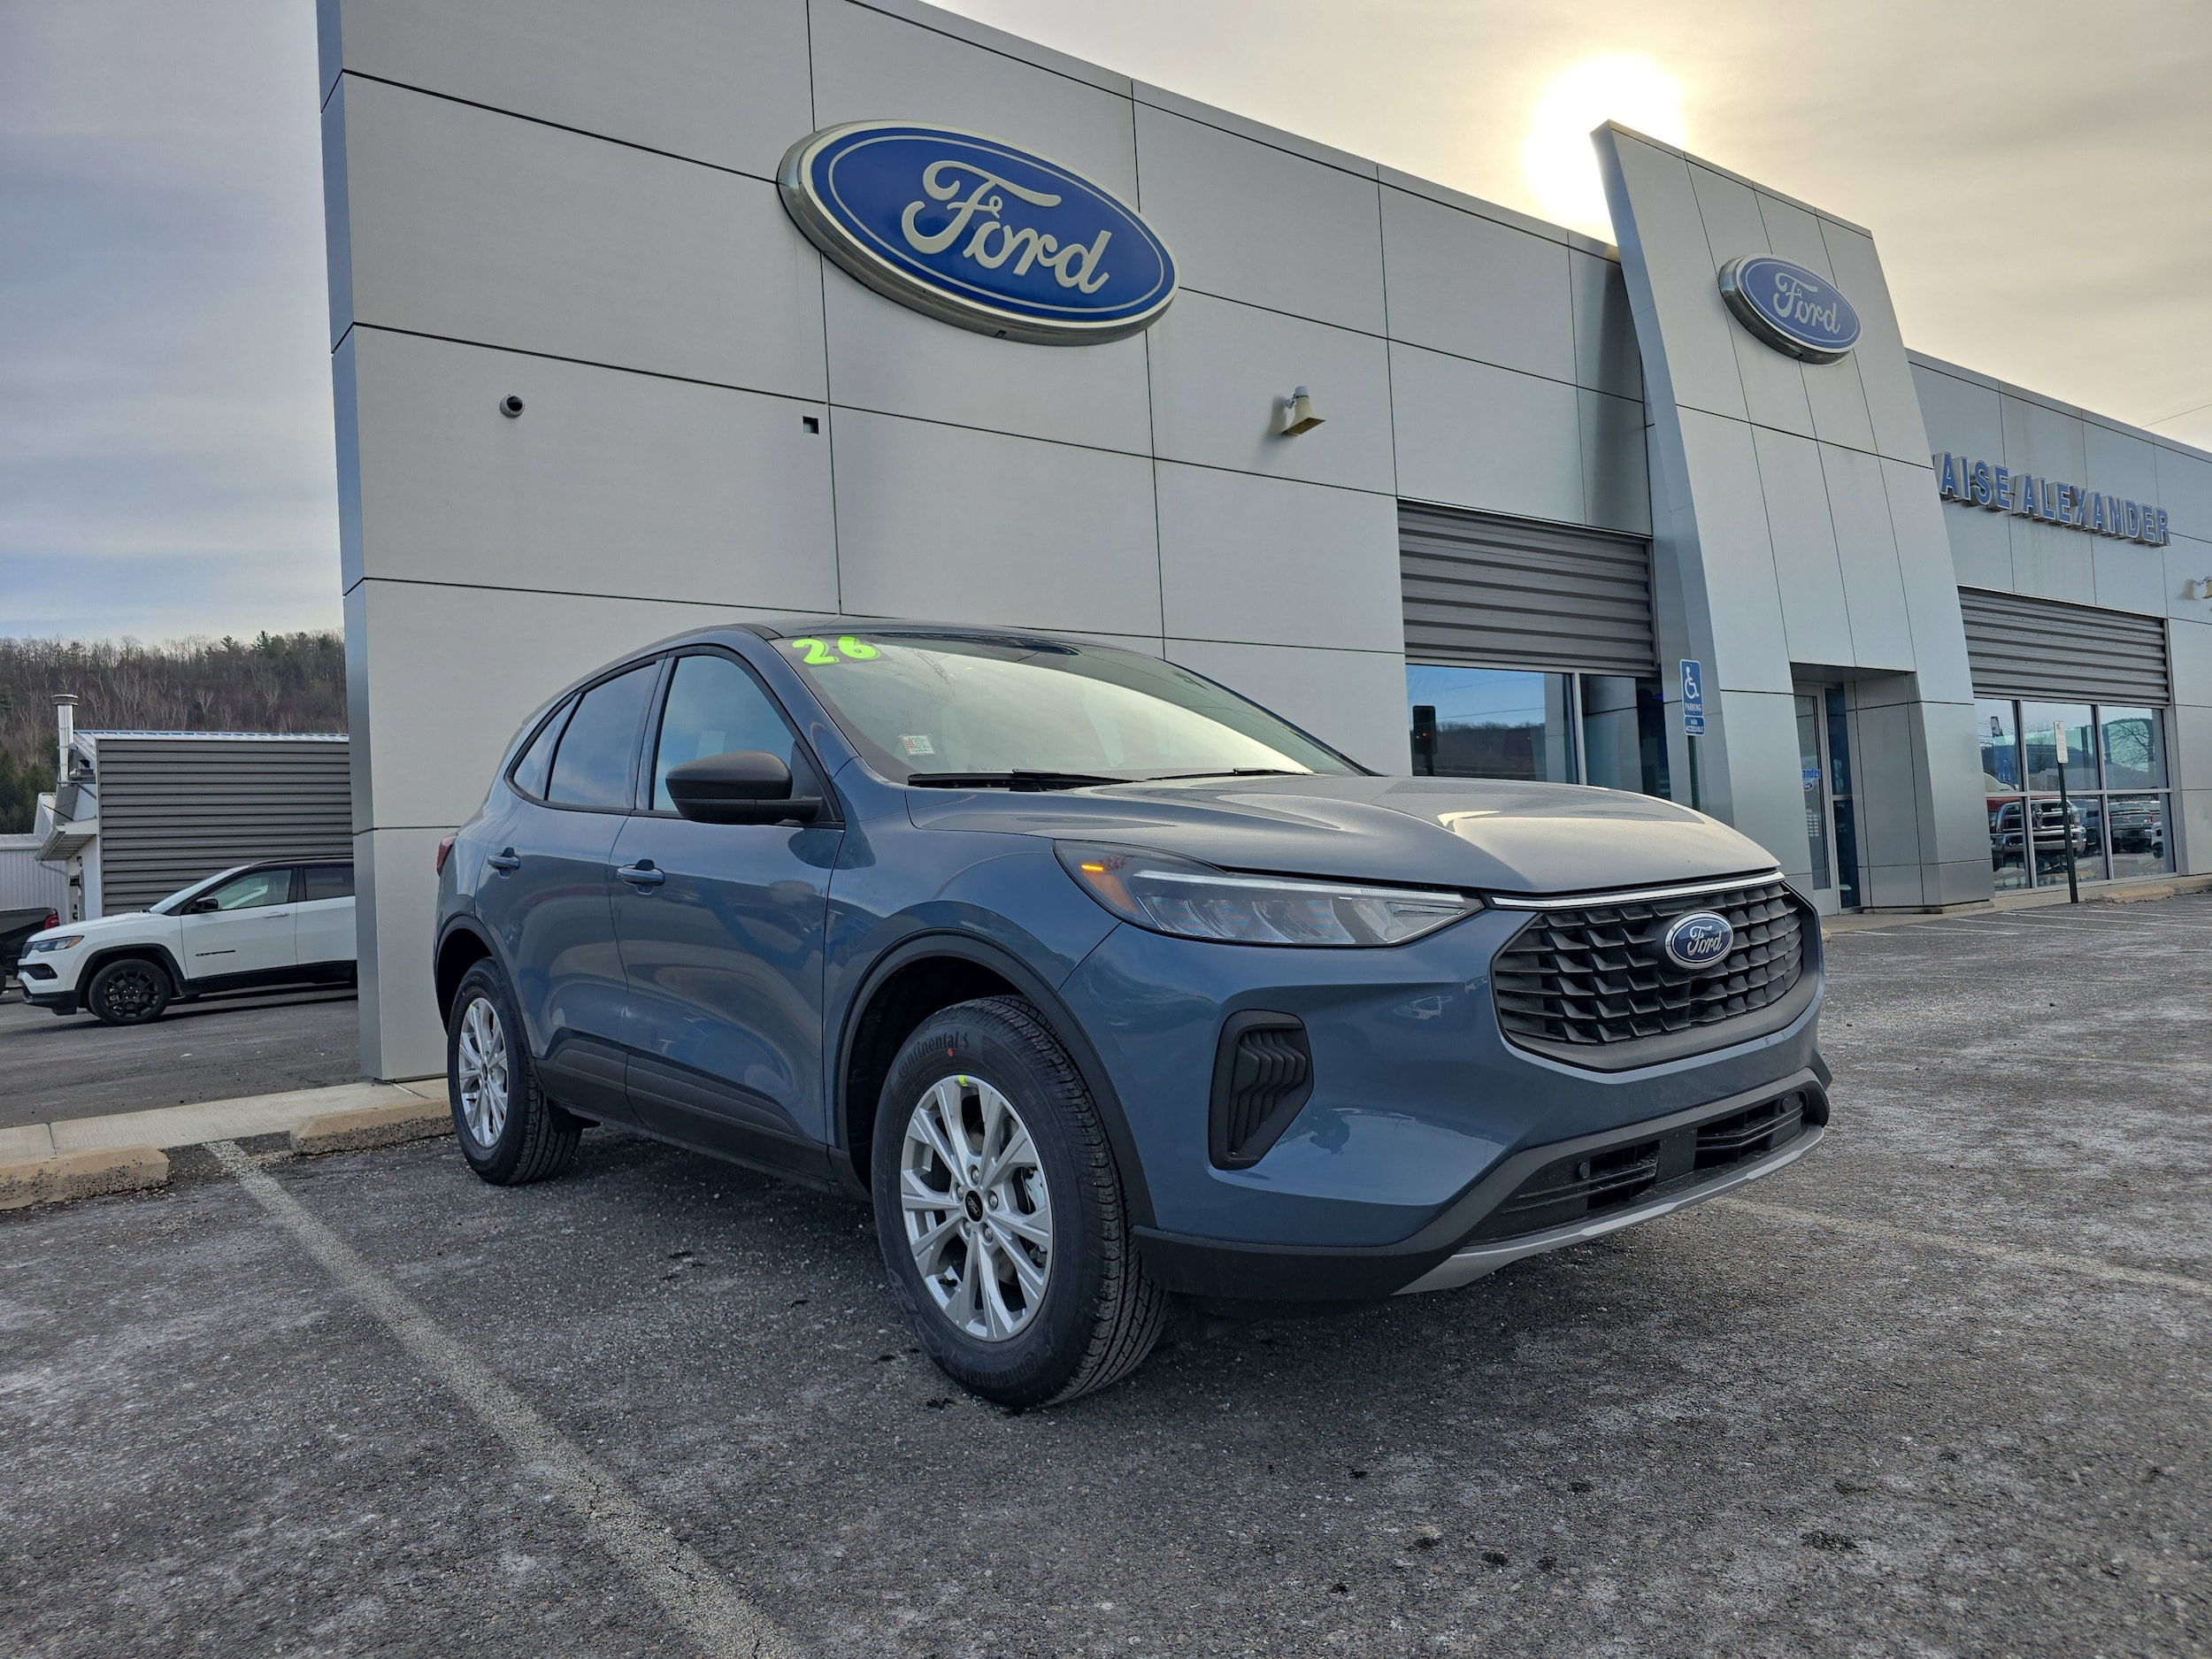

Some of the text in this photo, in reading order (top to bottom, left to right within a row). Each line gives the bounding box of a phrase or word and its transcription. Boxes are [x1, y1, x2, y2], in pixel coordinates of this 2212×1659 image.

[901, 159, 1113, 296] Ford
[1772, 272, 1841, 335] Ford
[1939, 451, 2171, 546] AISE ALEXANDER
[791, 635, 881, 666] 26
[1684, 703, 1702, 712] PARKING
[1686, 925, 1723, 956] Ford
[898, 1030, 959, 1079] Continental
